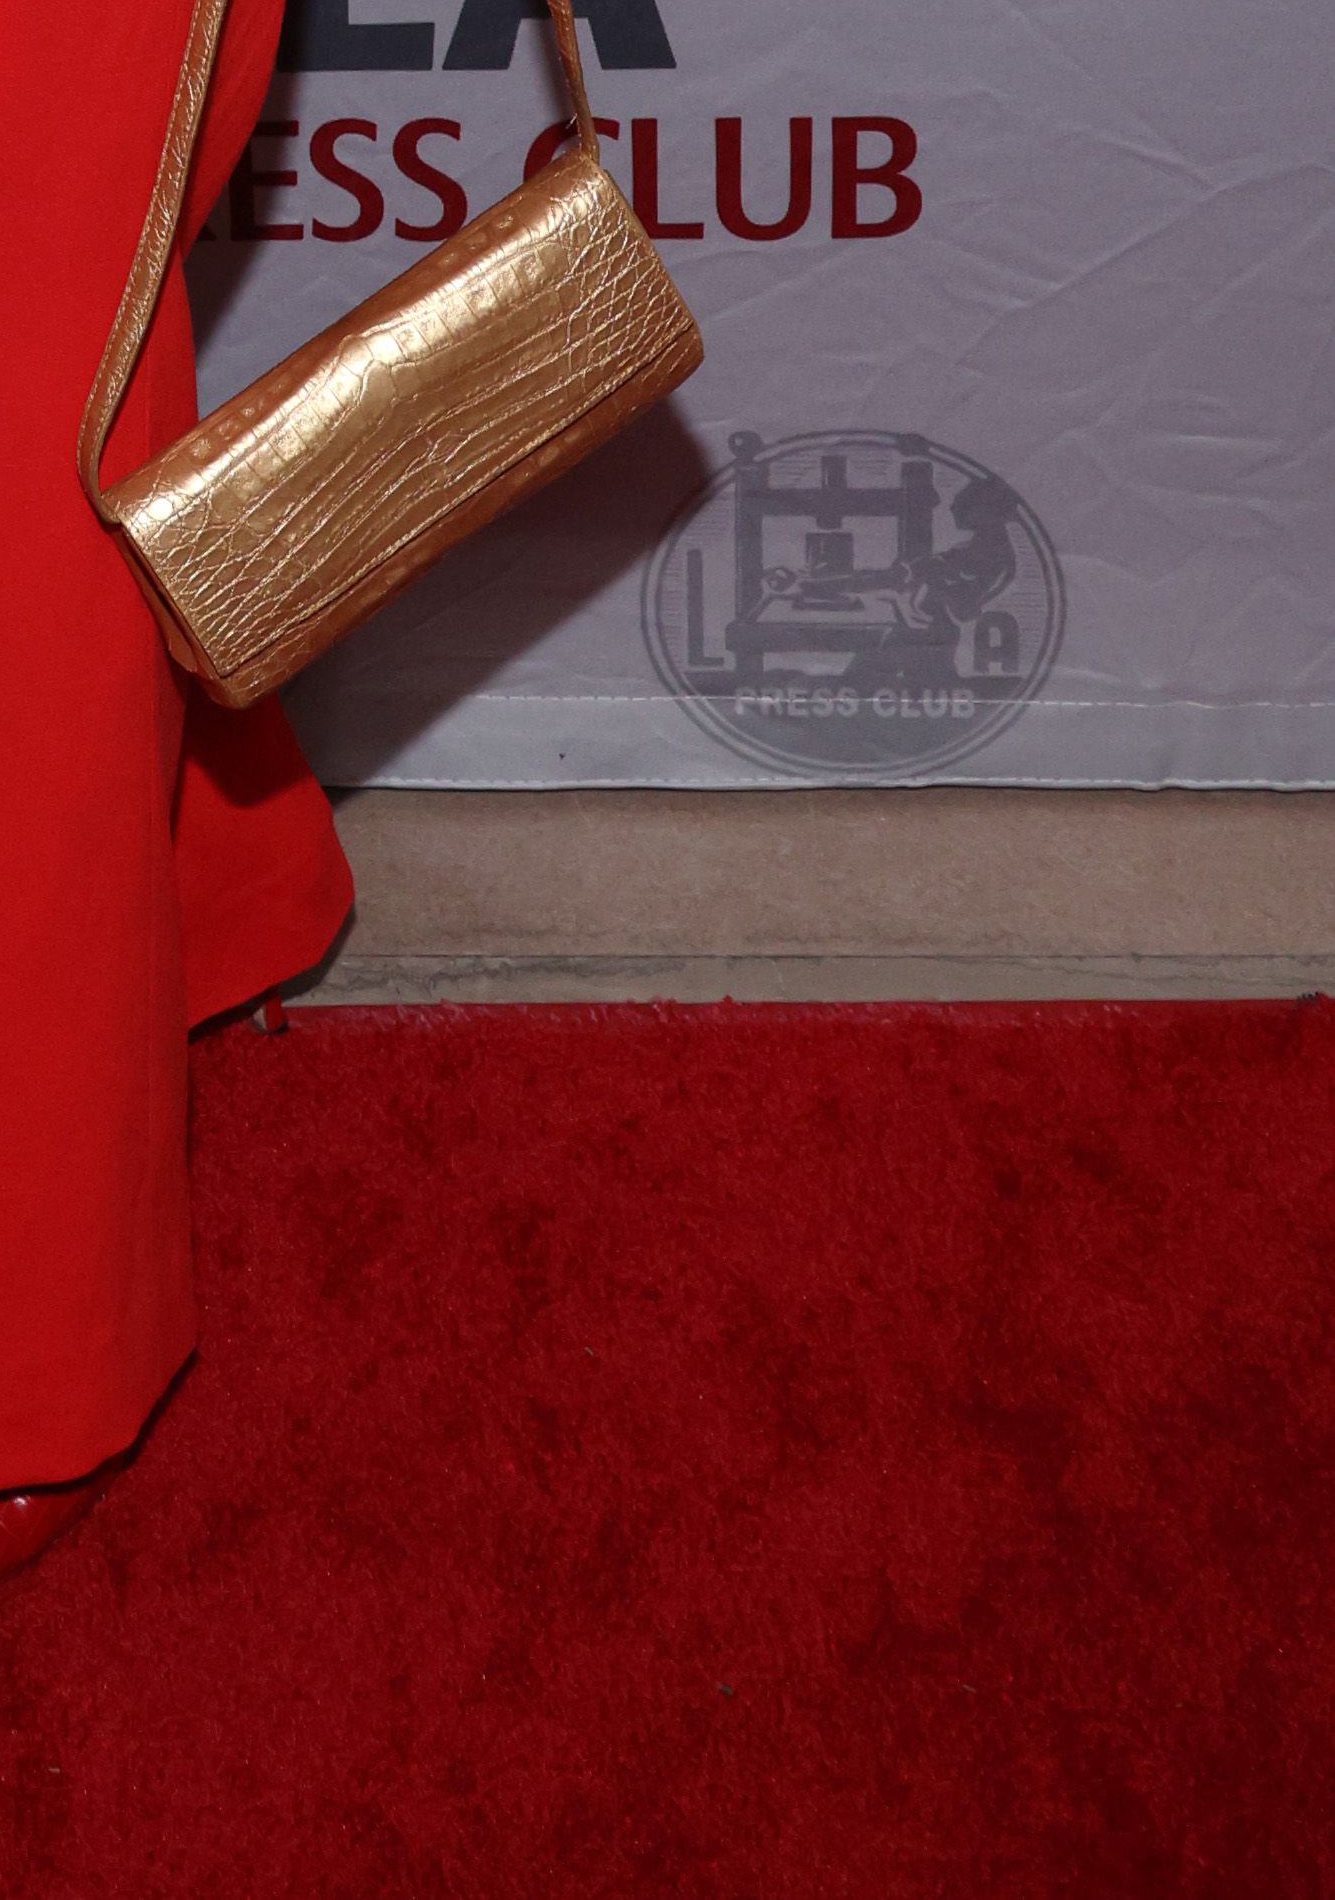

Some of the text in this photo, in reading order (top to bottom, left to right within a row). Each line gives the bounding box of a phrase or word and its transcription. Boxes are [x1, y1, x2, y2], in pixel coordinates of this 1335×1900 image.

[192, 117, 471, 244] ESS
[734, 685, 977, 719] PRESS CLUB
